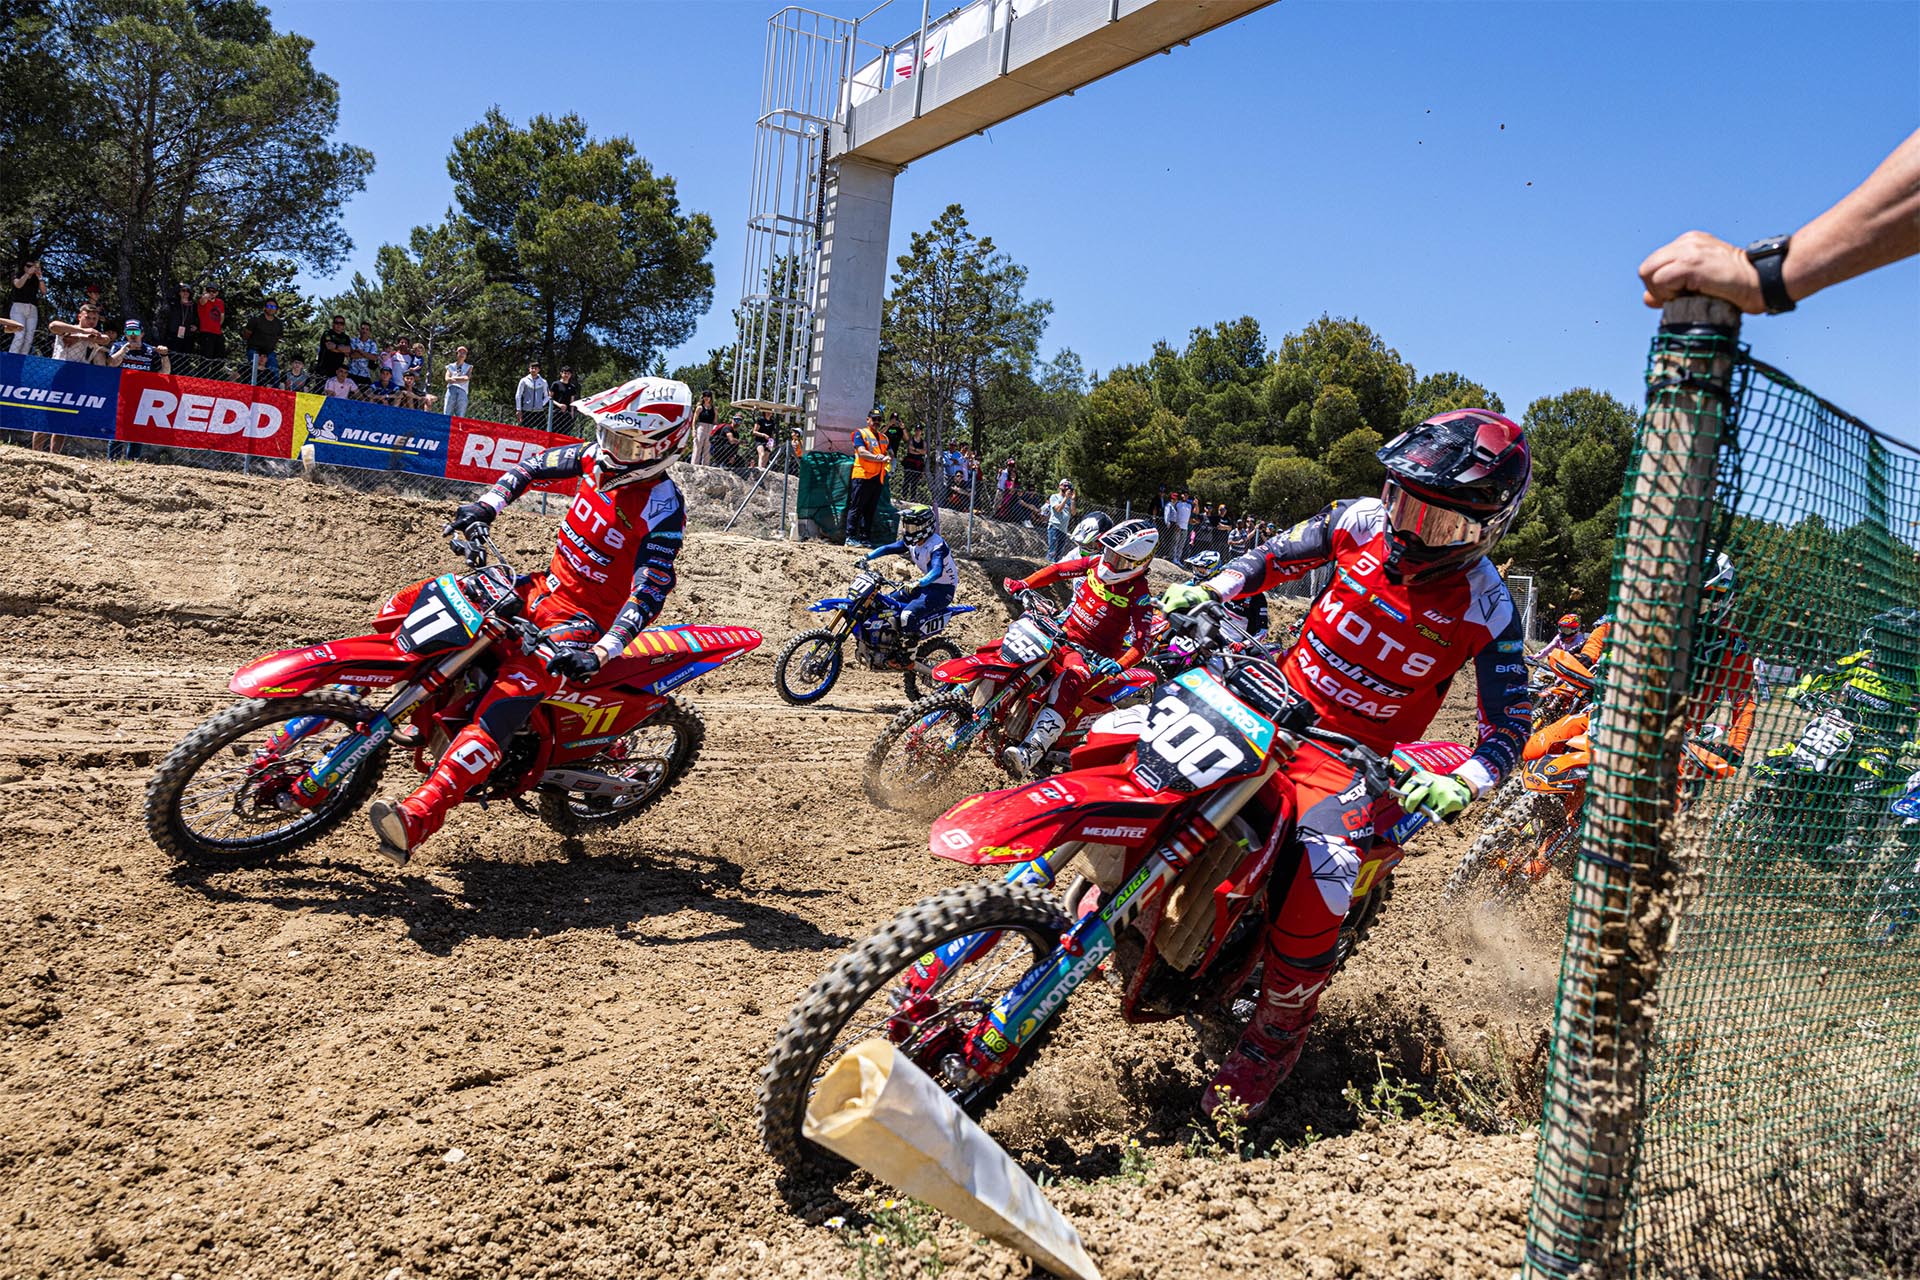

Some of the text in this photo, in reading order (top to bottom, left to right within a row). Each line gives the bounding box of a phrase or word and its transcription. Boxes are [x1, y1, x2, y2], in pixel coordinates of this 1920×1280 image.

[0, 384, 107, 409] ICHELIN
[133, 388, 283, 439] REDD
[340, 427, 440, 451] MICHELIN
[459, 433, 548, 472] RED
[570, 492, 626, 550] OTS
[556, 539, 609, 584] ASGAS
[403, 595, 458, 645] 11
[925, 614, 945, 634] 101
[1319, 589, 1437, 678] MOTS
[1422, 609, 1454, 624] WP
[1002, 627, 1045, 663] 255
[1298, 647, 1401, 718] GASGAS
[581, 704, 623, 736] 11
[335, 724, 391, 775] MOTOREX
[1140, 695, 1245, 789] 300
[1081, 825, 1148, 839] MEQUITEC
[1341, 802, 1376, 831] GAS
[1032, 936, 1112, 1022] MOTOREX
